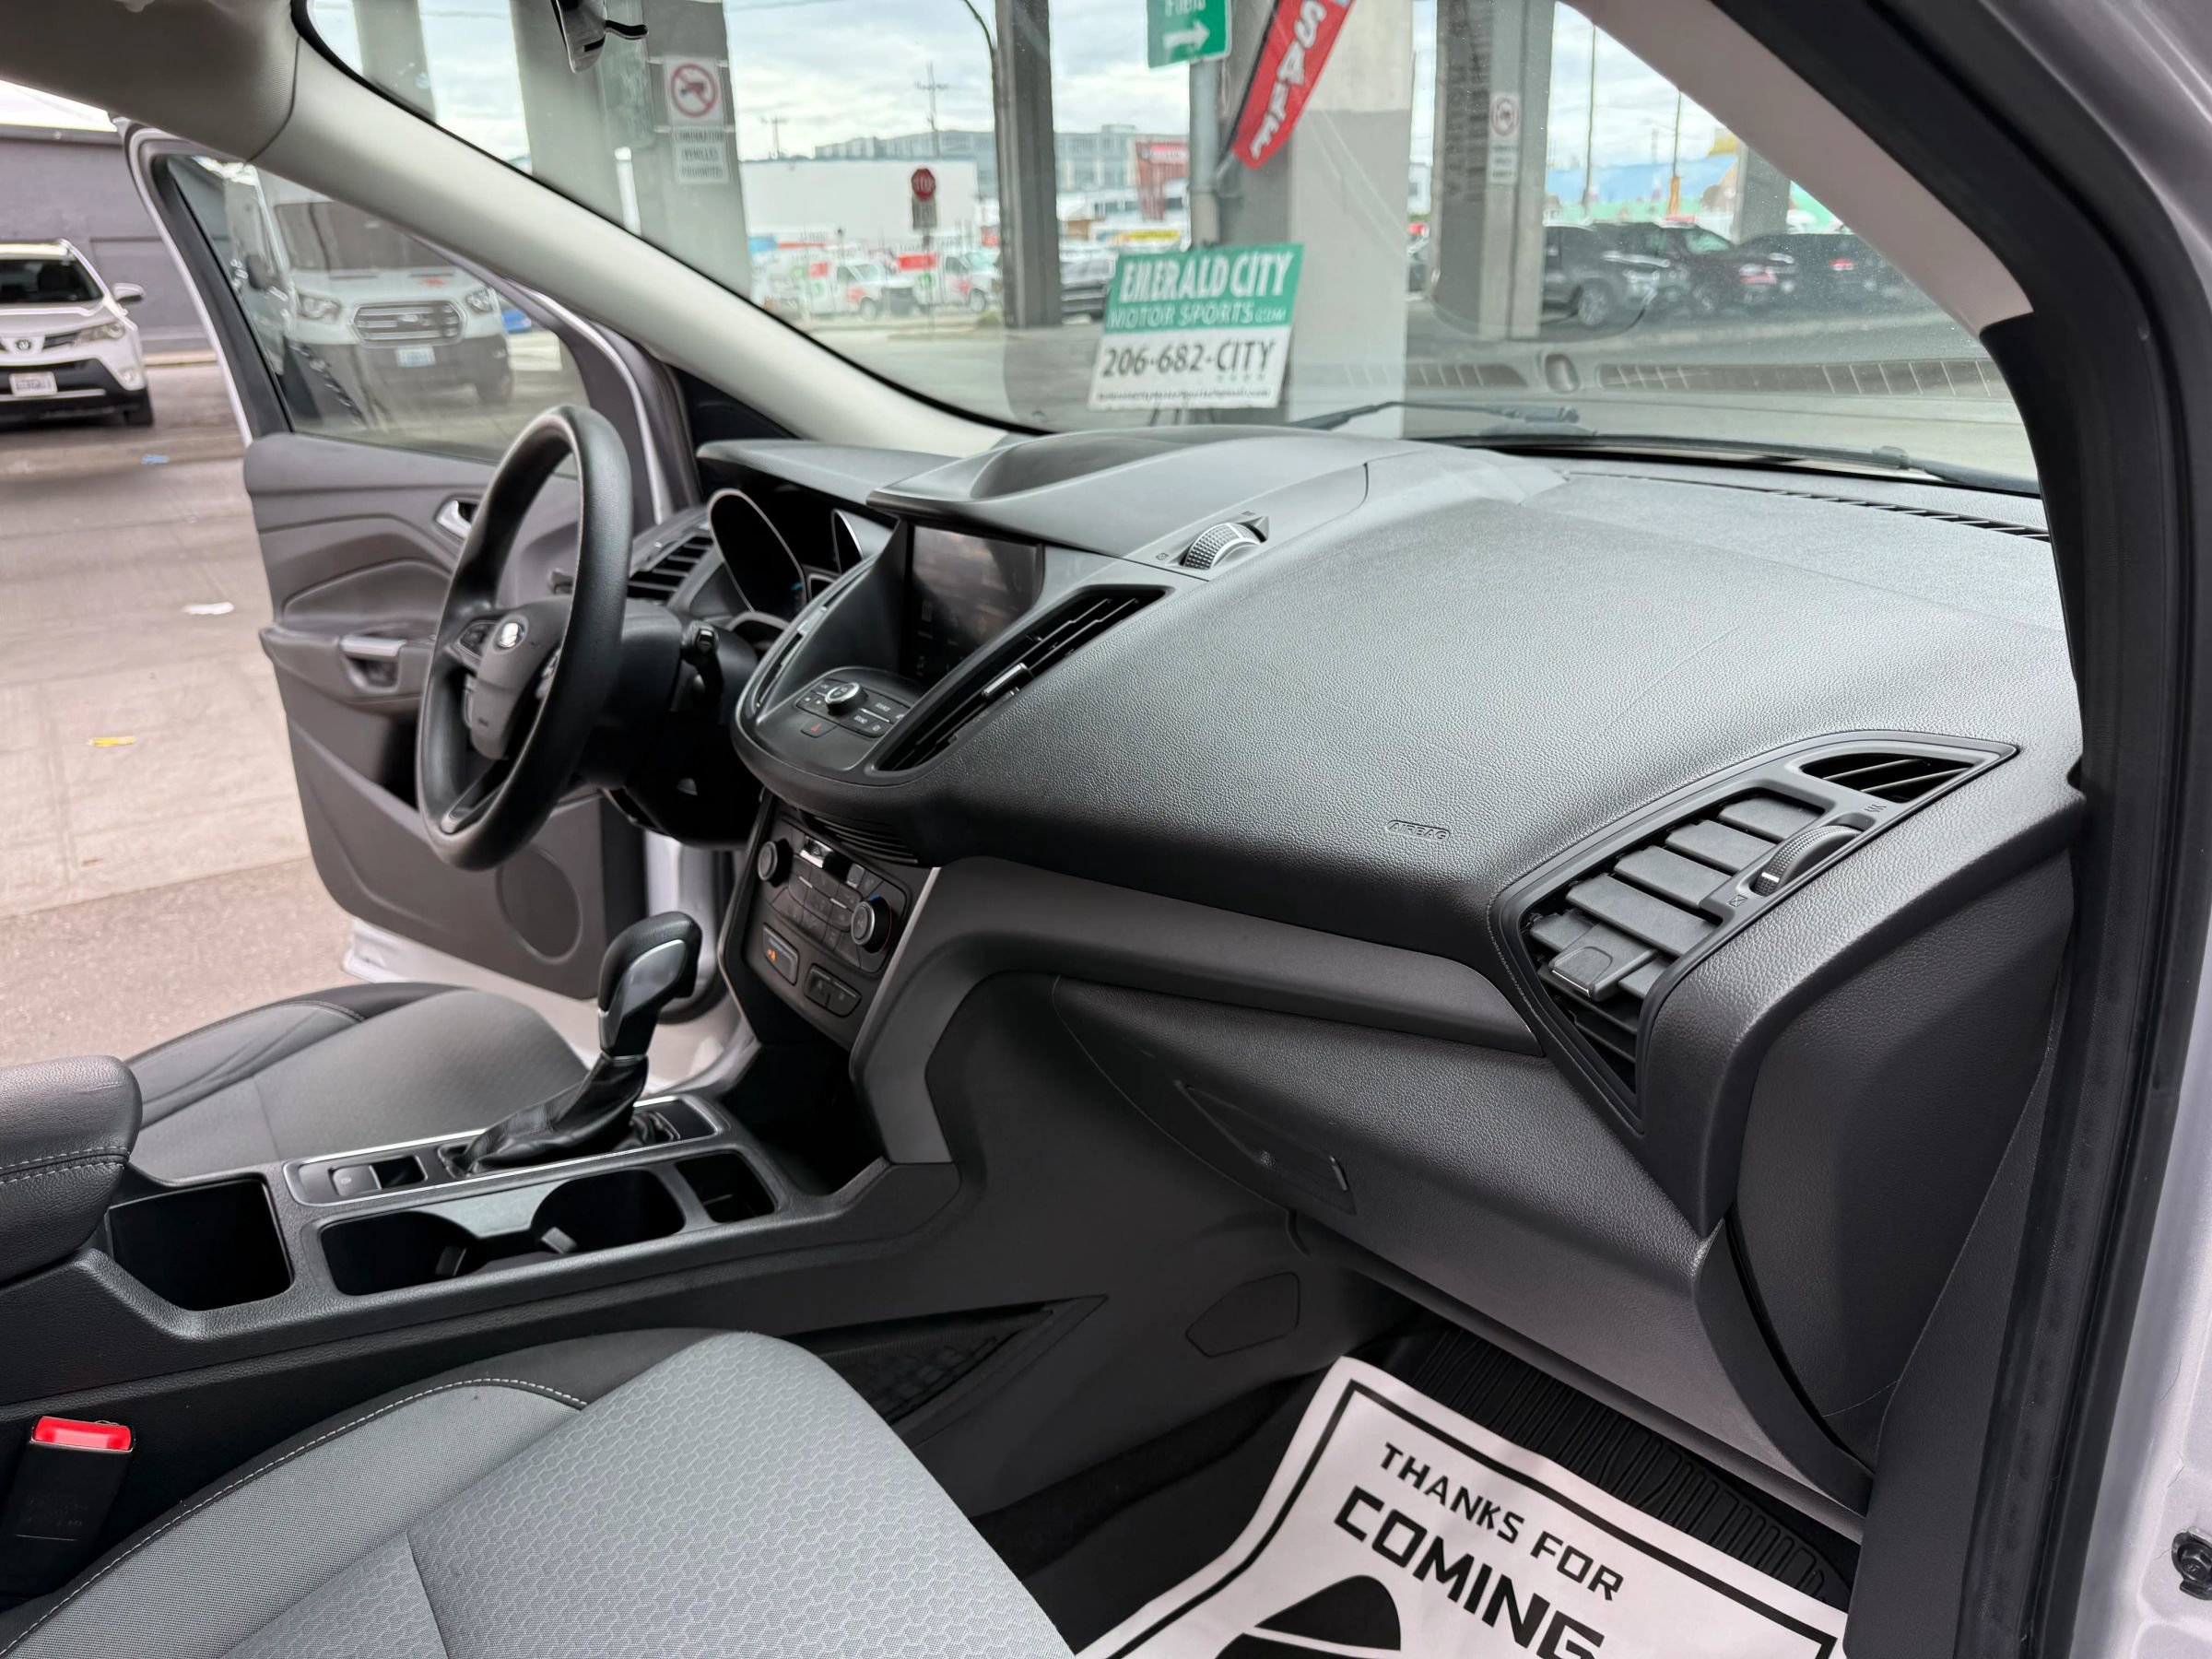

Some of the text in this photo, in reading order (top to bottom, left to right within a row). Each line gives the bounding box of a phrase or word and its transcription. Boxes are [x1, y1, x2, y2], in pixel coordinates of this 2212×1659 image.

[1250, 0, 1326, 159] SALE
[1120, 252, 1293, 303] EMERALD CITY
[1107, 305, 1176, 329] MOTOR
[1103, 340, 1277, 377] 206-682-CITY
[1388, 822, 1447, 840] AIRBAG
[1381, 1442, 1624, 1601] THANKS FOR
[1335, 1486, 1605, 1659] COMING
